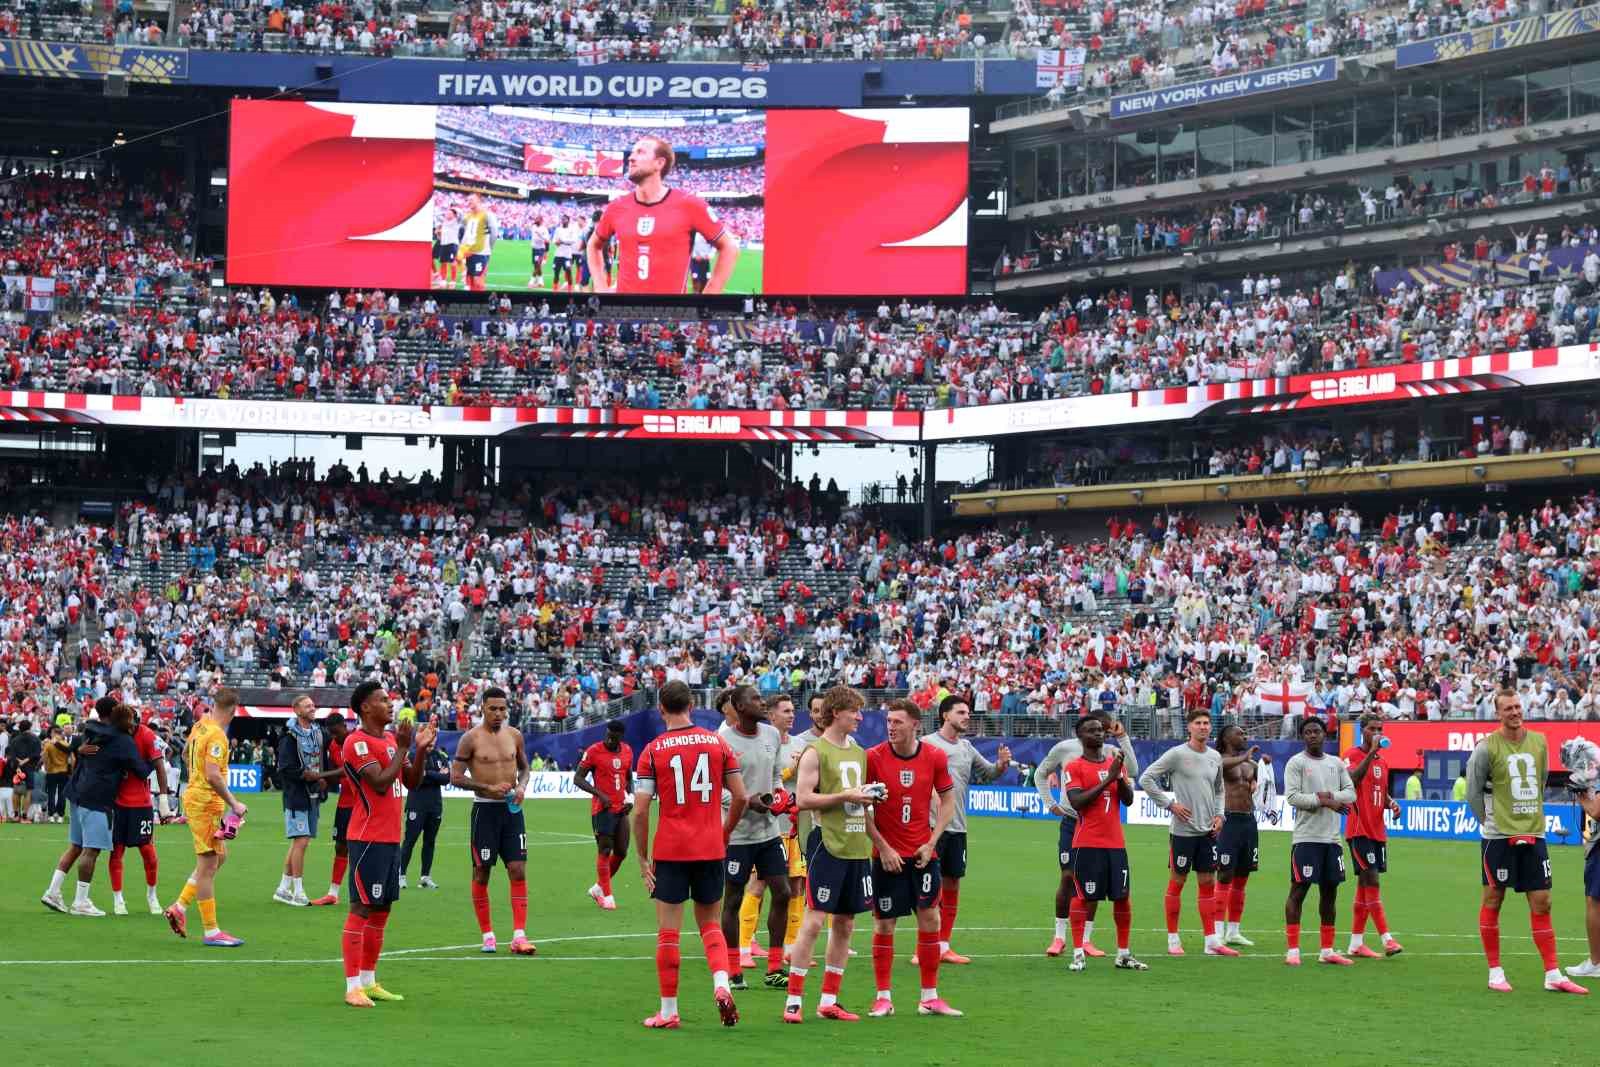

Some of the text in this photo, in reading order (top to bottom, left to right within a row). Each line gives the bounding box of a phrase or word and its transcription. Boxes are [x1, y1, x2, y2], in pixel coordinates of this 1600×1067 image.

[438, 74, 768, 99] FIFA WORLD CUP 2026
[1119, 64, 1326, 113] NEW YORK NEW JERSEY
[638, 255, 650, 280] 9
[1338, 372, 1396, 397] ENGLAND
[225, 404, 306, 424] WORLD
[308, 408, 351, 425] CUP
[352, 409, 433, 429] 2026
[676, 415, 741, 434] ENGLAND
[655, 733, 720, 751] J.HENDERSON
[227, 768, 257, 787] ITES
[532, 775, 555, 793] the
[669, 752, 713, 805] 14
[969, 789, 1009, 812] FOOTBALL
[1010, 791, 1040, 813] UNITES
[1103, 796, 1111, 813] 7
[1373, 791, 1382, 808] 11
[902, 804, 911, 824] 8
[1407, 806, 1450, 832] UNITES
[1452, 804, 1478, 834] the
[1545, 815, 1562, 833] FA
[140, 820, 153, 835] 25
[1211, 845, 1218, 862] 5
[862, 875, 873, 897] 18
[922, 872, 932, 893] 8
[1122, 869, 1129, 888] 7
